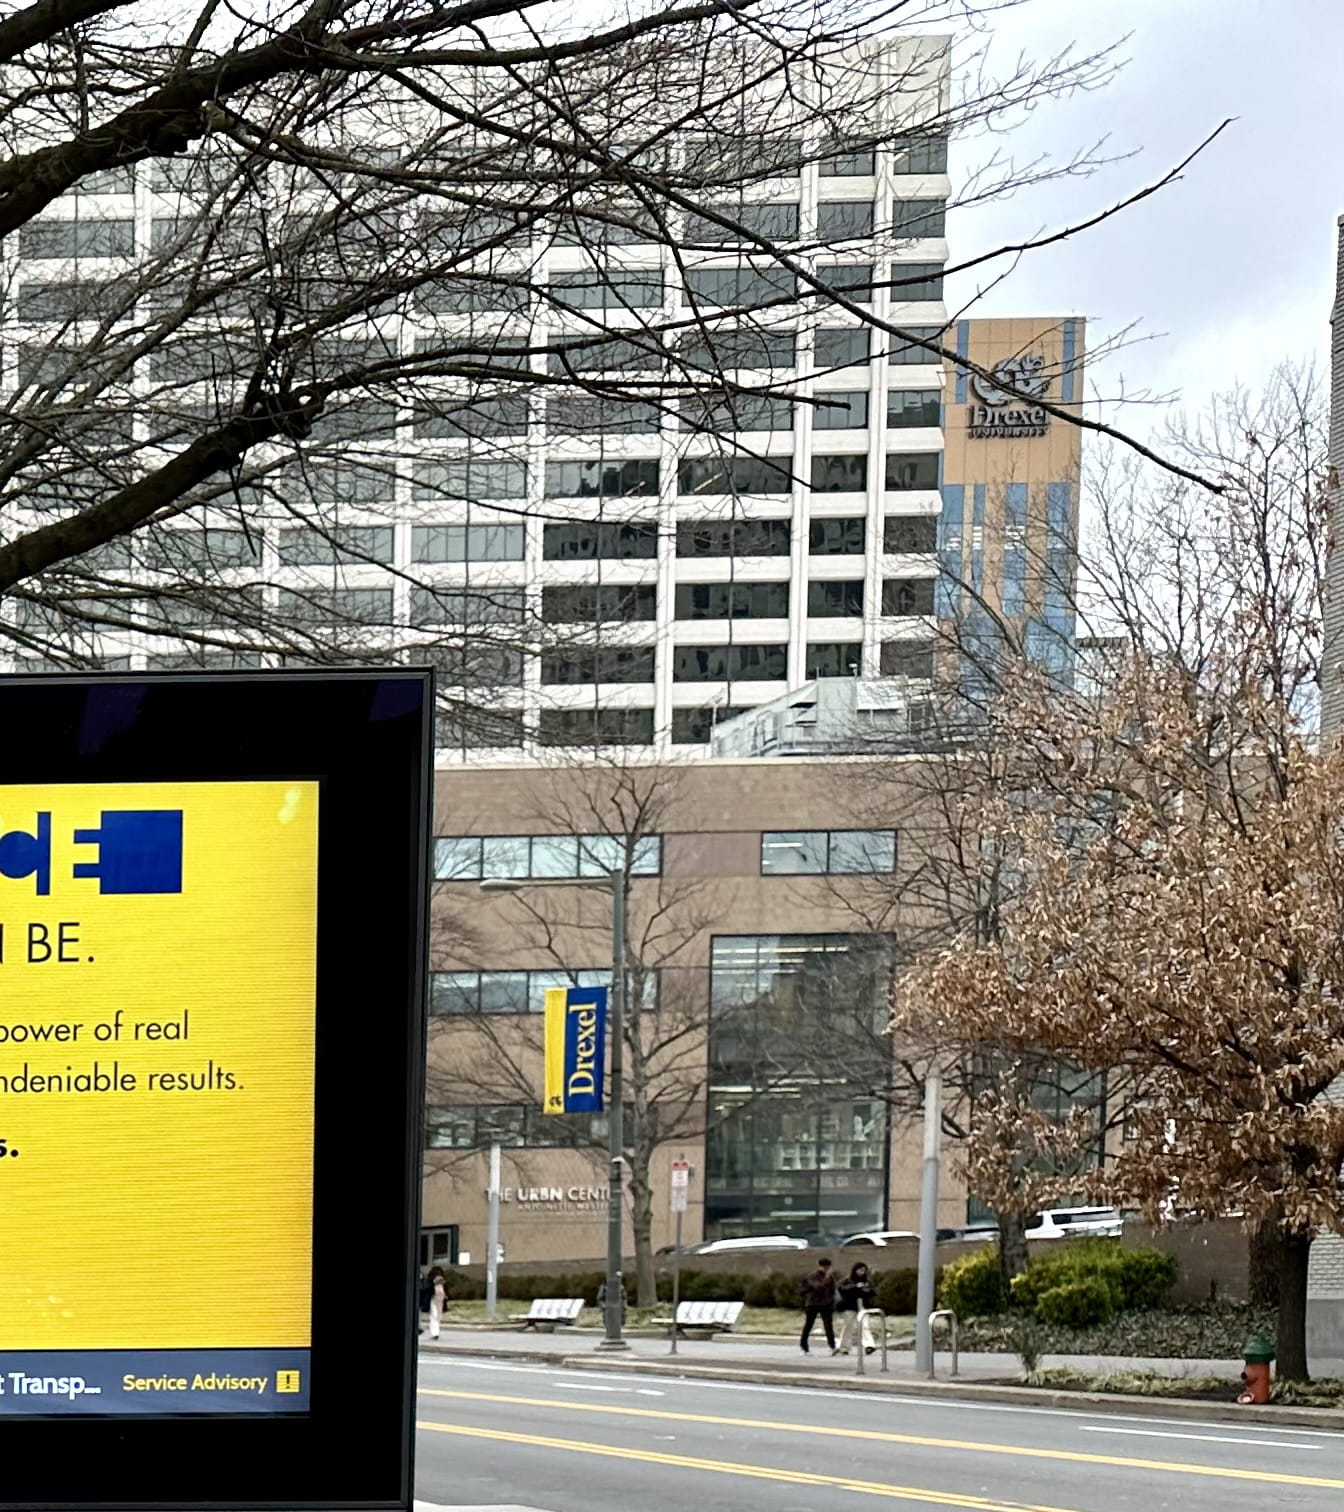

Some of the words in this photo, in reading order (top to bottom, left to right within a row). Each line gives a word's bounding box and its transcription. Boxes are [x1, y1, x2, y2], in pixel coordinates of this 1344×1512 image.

[27, 921, 95, 964] BE.
[94, 1009, 124, 1042] of
[134, 1009, 188, 1041] real
[568, 1002, 598, 1096] Drexel
[148, 1059, 244, 1091] results.
[517, 1187, 563, 1201] URBN
[122, 1374, 188, 1392] Service
[191, 1371, 269, 1394] Advisory
